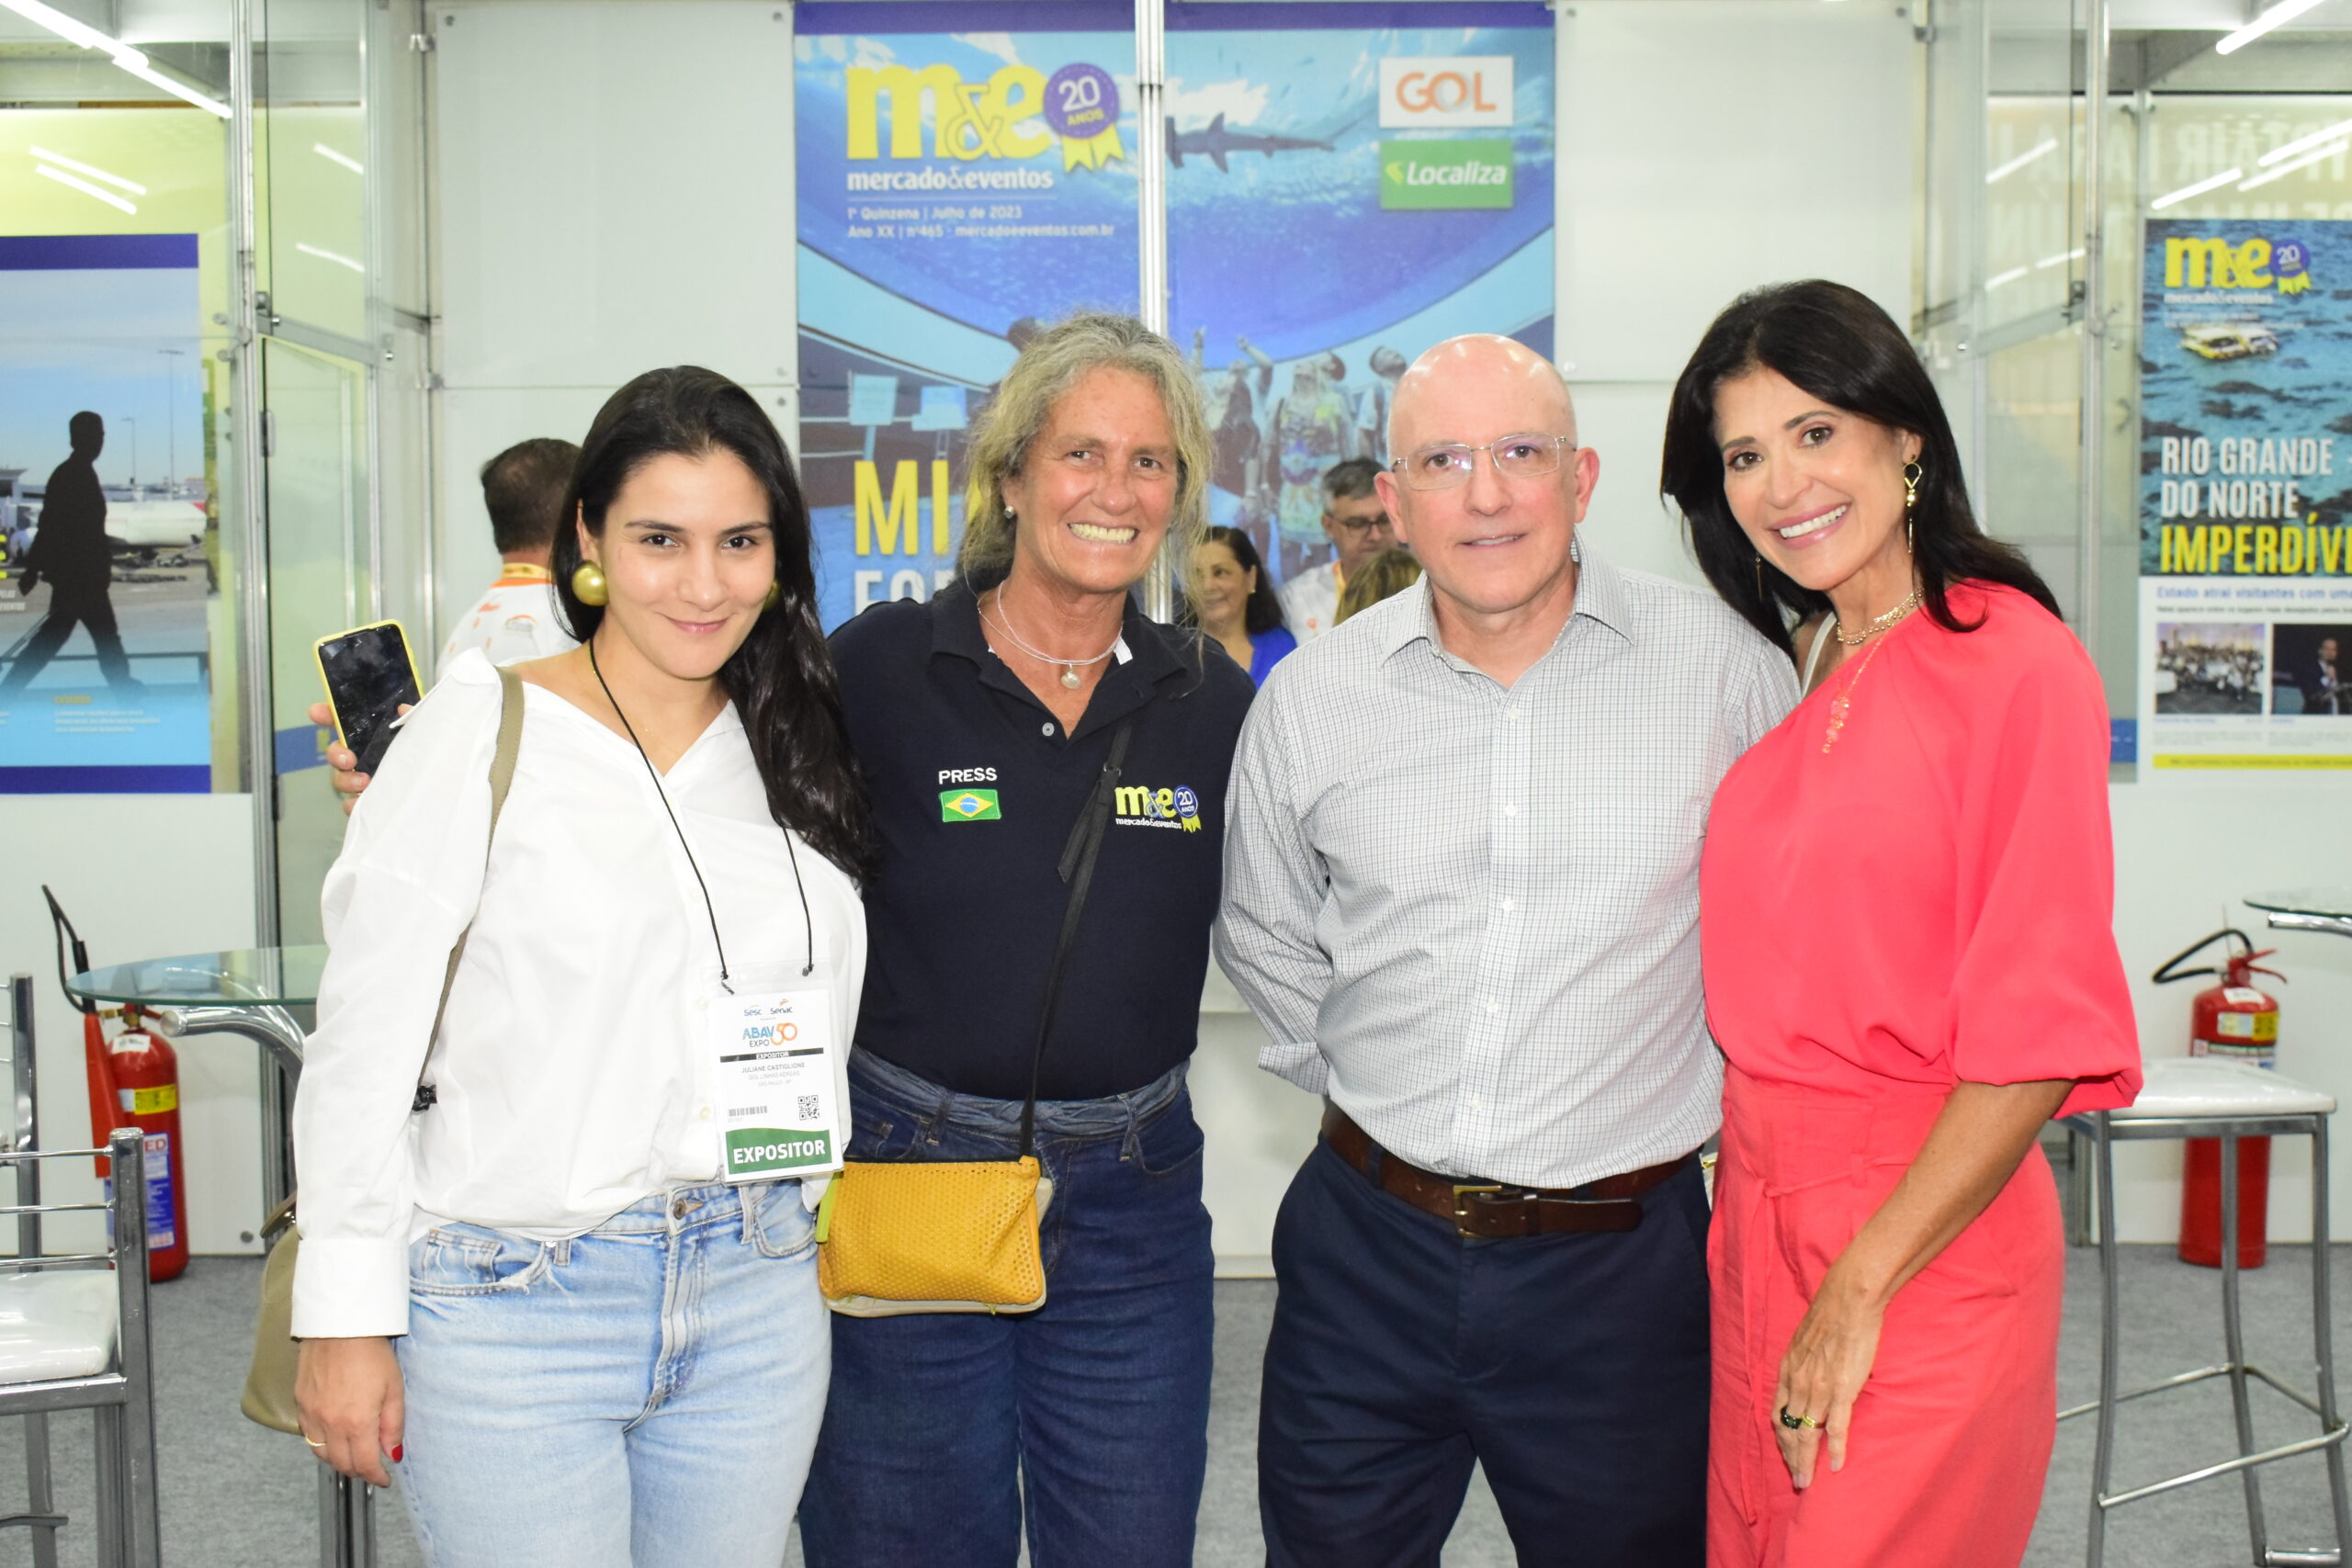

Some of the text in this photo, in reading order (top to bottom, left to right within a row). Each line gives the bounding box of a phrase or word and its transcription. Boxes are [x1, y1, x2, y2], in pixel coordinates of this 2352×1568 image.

[1058, 75, 1101, 112] 20
[1396, 72, 1498, 113] GOL
[845, 63, 1054, 161] m&e
[1068, 107, 1105, 126] ANOS
[847, 166, 1054, 190] mercado&eventos
[1407, 160, 1509, 186] Localiza
[861, 206, 920, 220] Quinzena
[931, 205, 965, 220] Julho
[968, 205, 986, 219] de
[989, 204, 1023, 219] 2023
[847, 225, 873, 239] Ano
[876, 225, 895, 238] XX
[2164, 237, 2275, 289] m&e
[2276, 244, 2301, 265] 20
[2161, 436, 2334, 476] RIO GRANDE
[2161, 480, 2300, 519] DO NORTE
[938, 767, 997, 784] PRESS
[1114, 785, 1177, 818] m&e
[1177, 790, 1193, 807] 20
[1115, 817, 1182, 829] mercado&eventos
[742, 1022, 798, 1045] ABAV 50
[749, 1039, 770, 1048] EXPO
[756, 1051, 789, 1060] EXPOSITOR
[733, 1139, 826, 1165] EXPOSITOR
